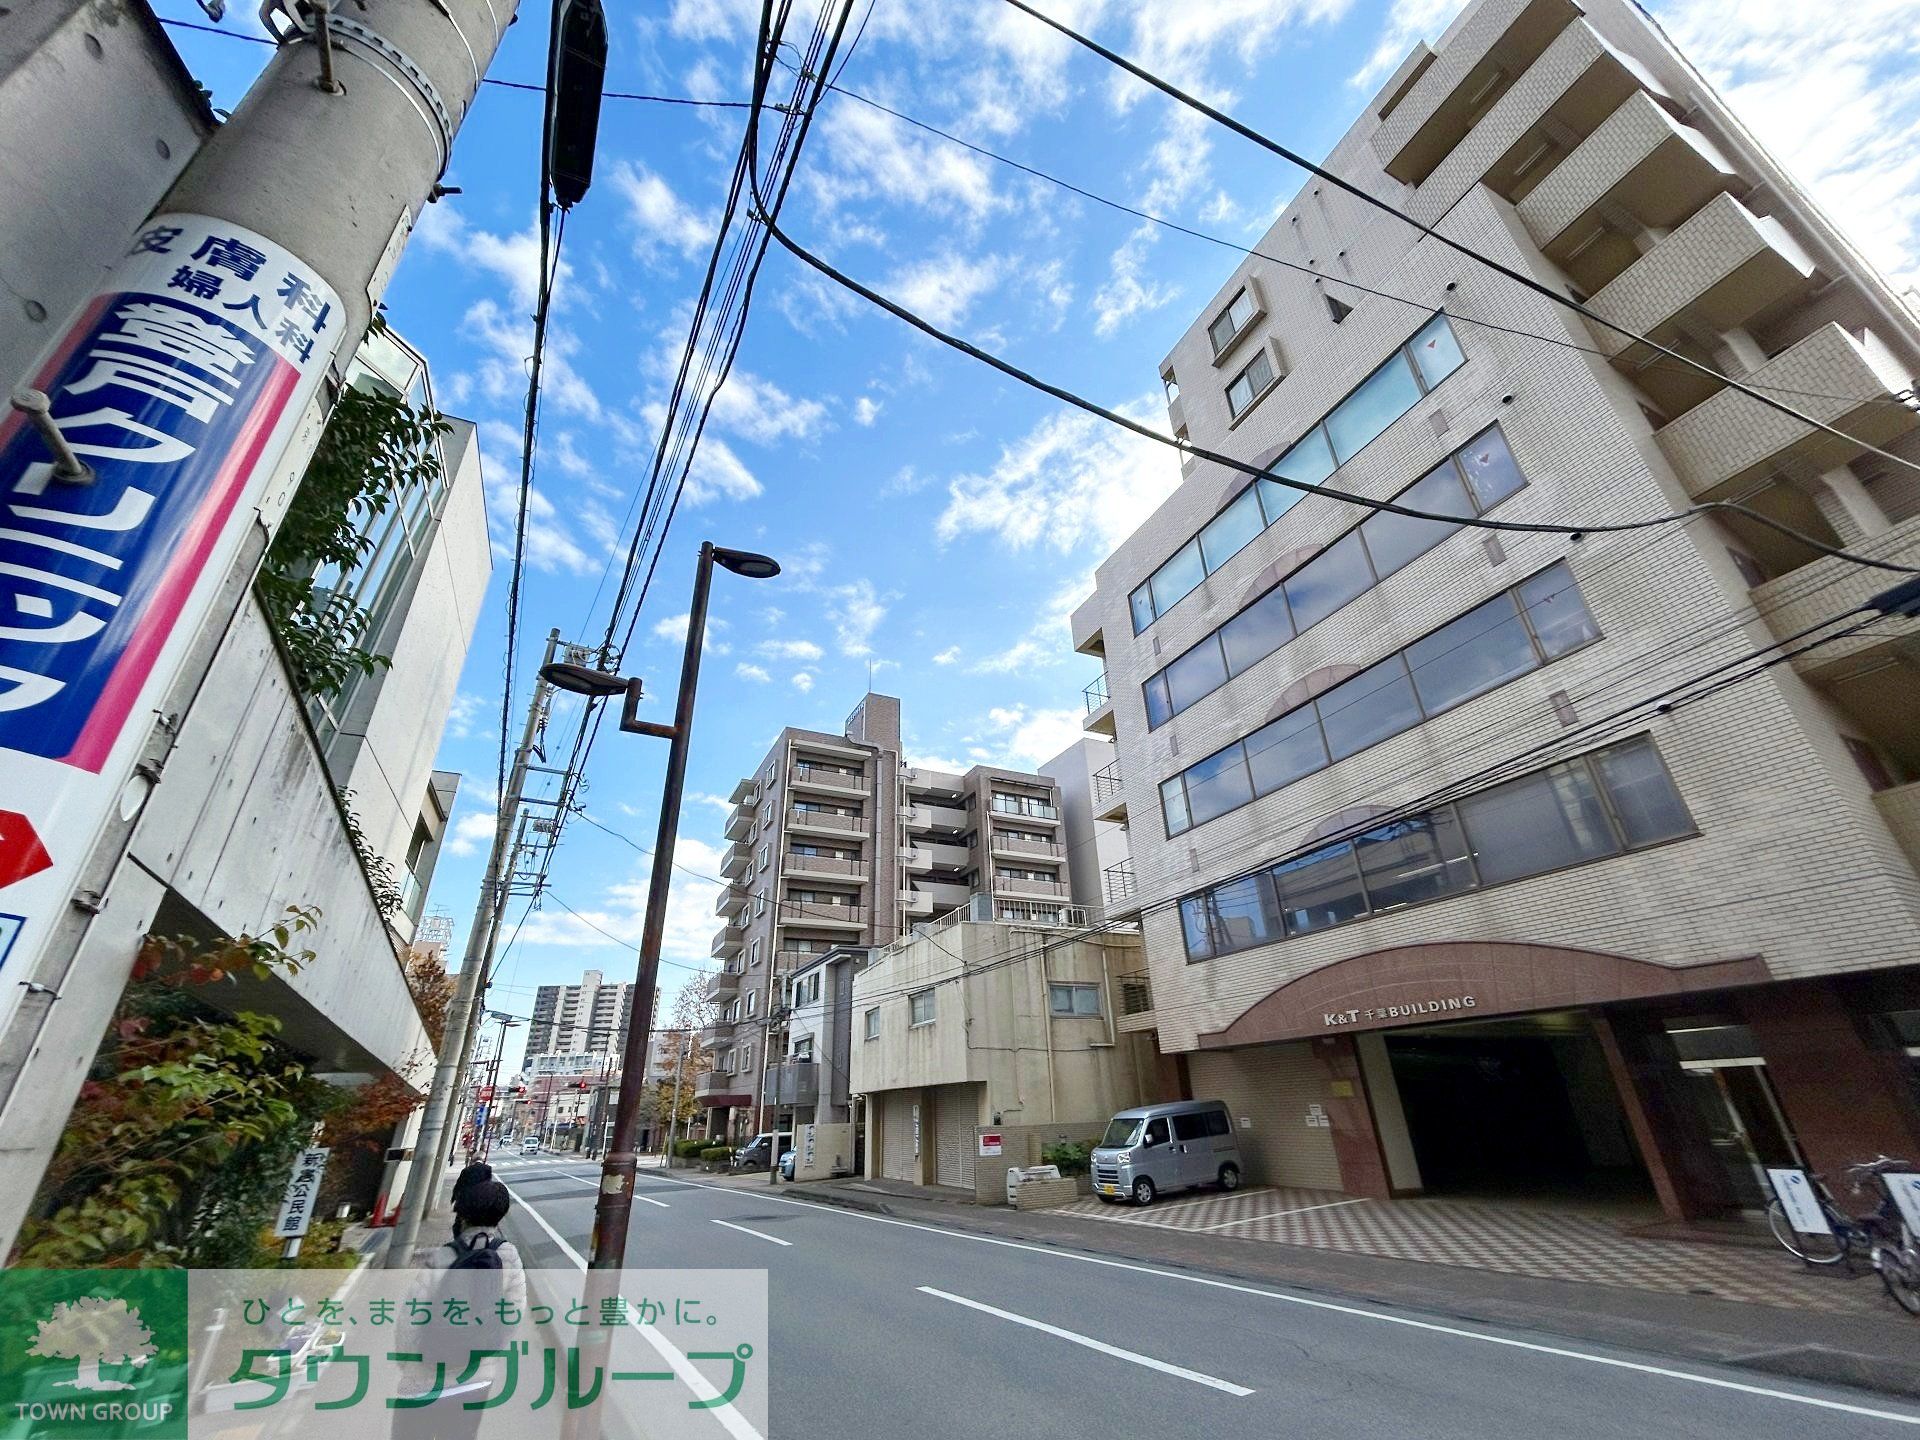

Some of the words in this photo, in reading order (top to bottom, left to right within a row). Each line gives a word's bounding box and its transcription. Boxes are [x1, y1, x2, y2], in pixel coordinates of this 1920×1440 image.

[124, 225, 331, 334] 皮膚科
[167, 265, 314, 364] 婦人科
[1324, 1009, 1360, 1026] K&T
